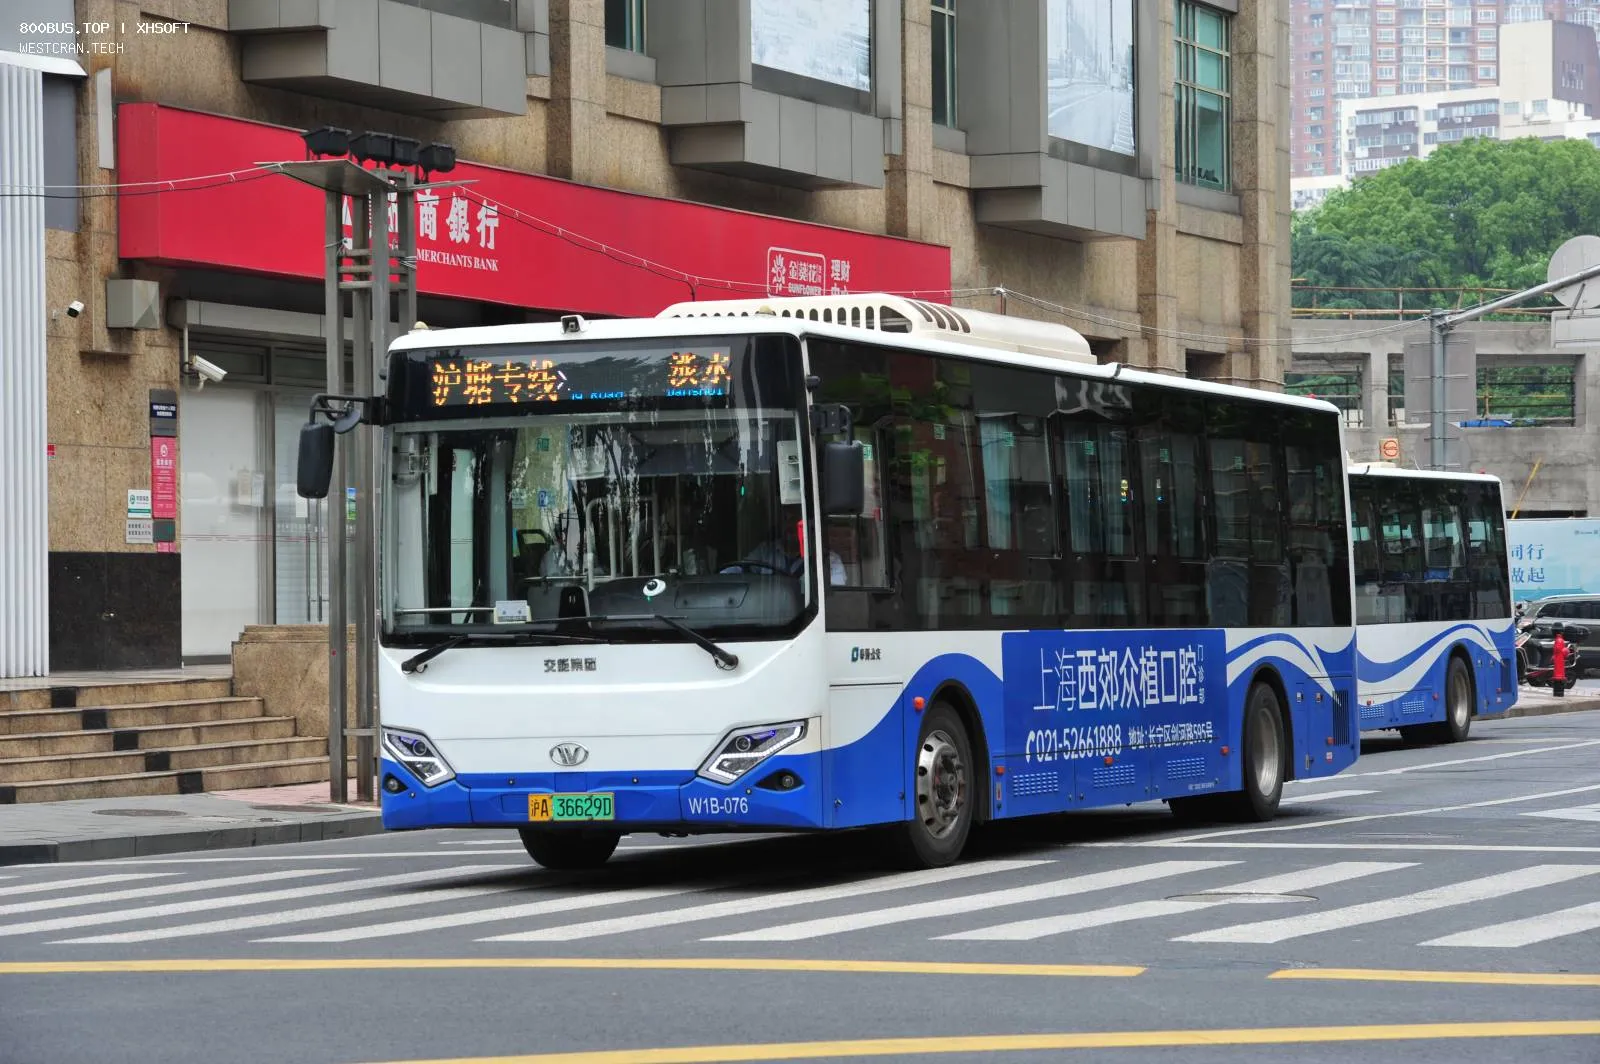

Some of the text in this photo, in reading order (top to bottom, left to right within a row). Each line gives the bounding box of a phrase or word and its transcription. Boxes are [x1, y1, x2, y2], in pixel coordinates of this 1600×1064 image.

[416, 248, 499, 272] MERCHANTS BANK
[831, 259, 850, 283] 理财
[788, 282, 822, 296] SUNFLOWER
[1036, 724, 1122, 763] 021-52661888
[556, 796, 612, 818] 36629D
[688, 796, 749, 815] W1B-076
